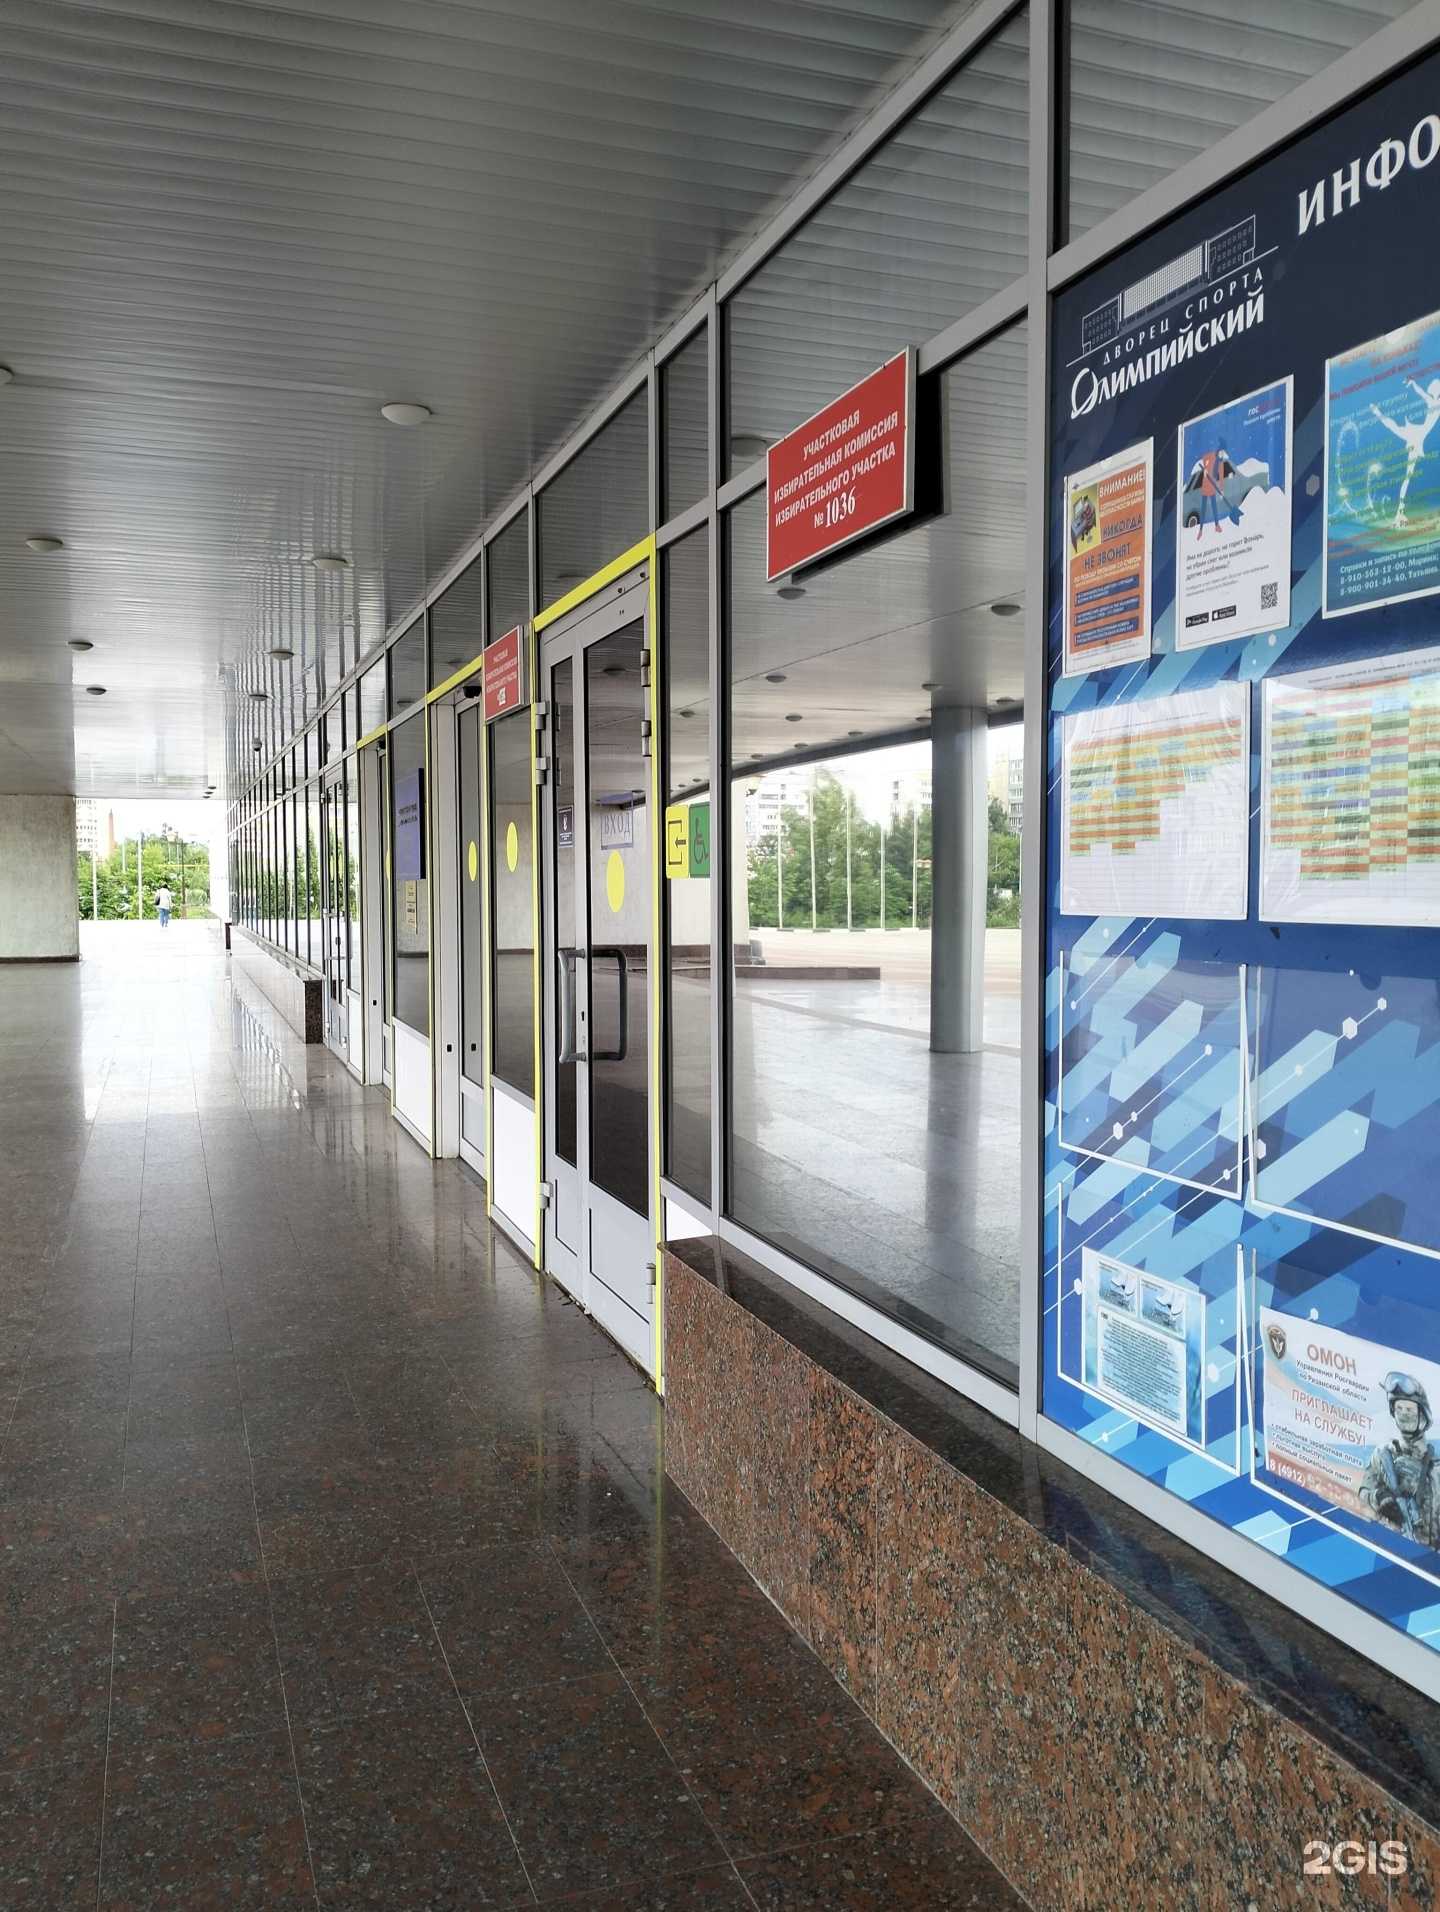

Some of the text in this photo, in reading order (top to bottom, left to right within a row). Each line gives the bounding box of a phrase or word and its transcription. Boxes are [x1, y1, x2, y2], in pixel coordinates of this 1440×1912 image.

[1298, 113, 1440, 236] ИНФО
[1103, 266, 1263, 365] ДВОРЕЦ СПОРТА
[774, 411, 898, 504] ИЗБИРАТЕЛЬНАЯ КОМИССИЯ
[803, 409, 860, 461] УЧАСТКОВАЯ
[775, 441, 896, 527] ИЗБИРАТЕЛЬНОГО УЧАСТКА
[605, 812, 631, 840] ВХОД
[1307, 1344, 1357, 1376] ОМОН
[1292, 1389, 1374, 1430] ПРИГЛАШАЕТ
[1294, 1407, 1366, 1448] НА СЛУЖБУ!
